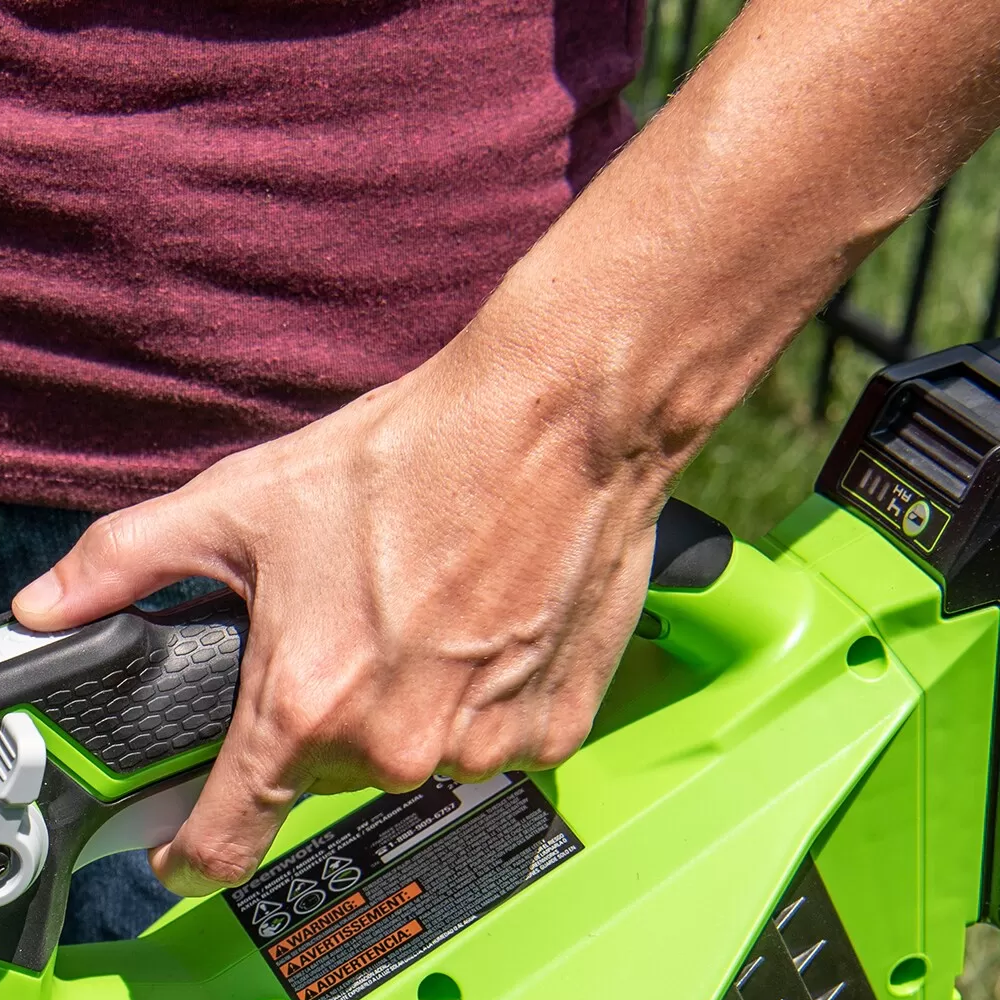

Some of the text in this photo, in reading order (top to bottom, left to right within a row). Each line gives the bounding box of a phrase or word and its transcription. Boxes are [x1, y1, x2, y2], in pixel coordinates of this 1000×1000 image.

[241, 897, 260, 912] AXIAL
[262, 878, 290, 898] BLOWER
[295, 850, 335, 877] SOUFFLEUSE
[337, 834, 361, 850] AXIALE
[366, 807, 402, 832] SOPLADOR
[403, 794, 423, 808] AXIAL
[388, 803, 456, 848] 1-888-909-6757
[231, 831, 335, 902] greenworks
[286, 899, 357, 948] WARNING:
[296, 891, 410, 966] AVERTISSEMENT:
[315, 928, 411, 992] ADVERTENCIA:
